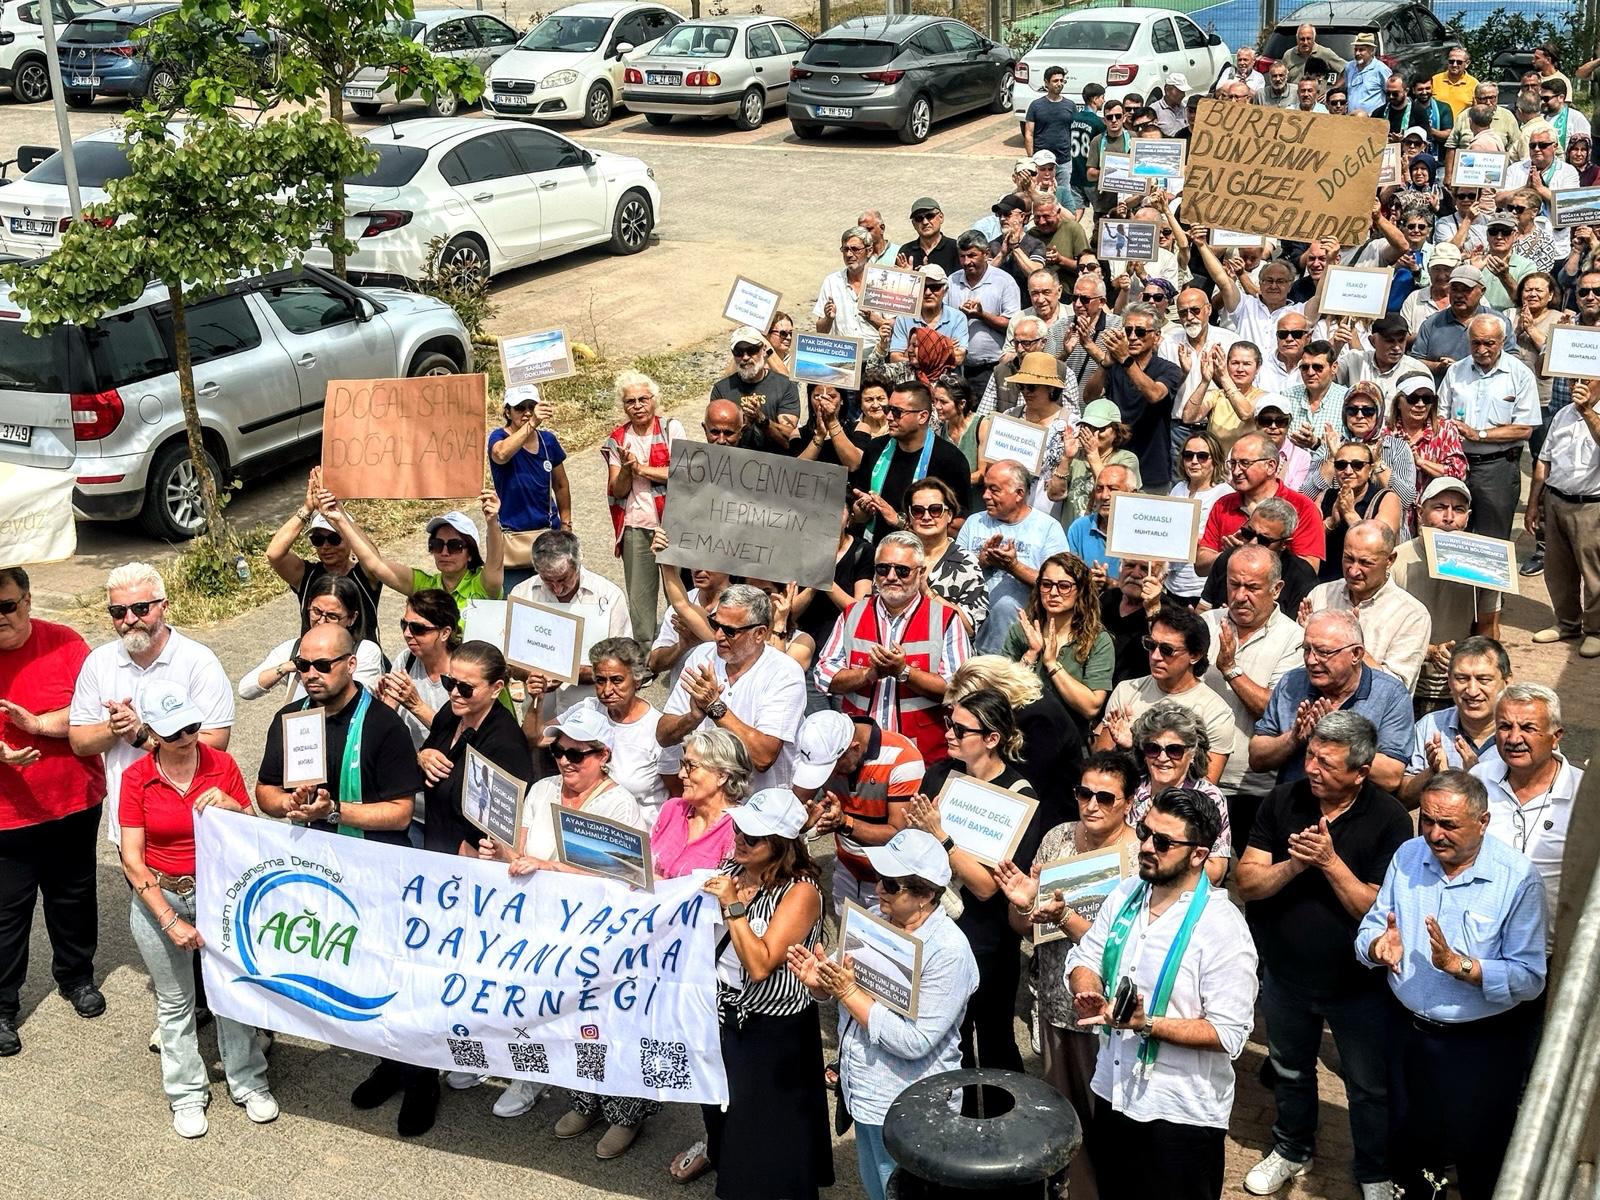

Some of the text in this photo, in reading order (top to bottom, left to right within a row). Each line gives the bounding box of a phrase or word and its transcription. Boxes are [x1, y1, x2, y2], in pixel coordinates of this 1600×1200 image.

[1204, 101, 1317, 145] BURASI
[1070, 130, 1090, 157] 58
[1190, 129, 1331, 173] DÜNYANIN
[1184, 164, 1226, 193] EN
[1316, 136, 1386, 202] DOĞAL
[15, 219, 22, 230] 34
[41, 222, 52, 232] 727
[1184, 192, 1368, 246] KUMSALIDIR
[800, 337, 815, 345] AYAK
[816, 339, 833, 348] İZİMİZ
[806, 346, 831, 354] MAHMUZ
[333, 383, 411, 419] DOĞAL
[3, 424, 28, 440] 3749
[995, 429, 1020, 442] MAHMUZ
[330, 432, 413, 468] DOĞAL
[669, 447, 734, 488] AĞVA
[710, 498, 808, 532] HEPİMİZİN
[1132, 513, 1172, 524] GÖKMASLI
[1134, 528, 1169, 537] MUHTARLIĞI
[678, 531, 775, 565] EMANETİ
[534, 625, 552, 637] GÖÇE
[946, 813, 969, 826] MAVİ
[949, 798, 1014, 829] MAHMUZ DEĞİL,
[565, 816, 639, 846] AYAK İZİMİZ KALSIN,
[574, 827, 632, 850] MAHMUZ DEĞİL!
[221, 855, 344, 952] Yaşam Dayanışma Derneği
[402, 874, 703, 944] AĞVA YAŞAM
[1077, 902, 1101, 914] SAHİP
[256, 907, 359, 967] AĞVA
[404, 916, 682, 986] DAYANIŞMA
[440, 972, 661, 1018] DERNEĞİ
[868, 972, 890, 988] YOLUNU
[875, 983, 892, 997] ENGEL
[893, 993, 909, 1006] OLMA
